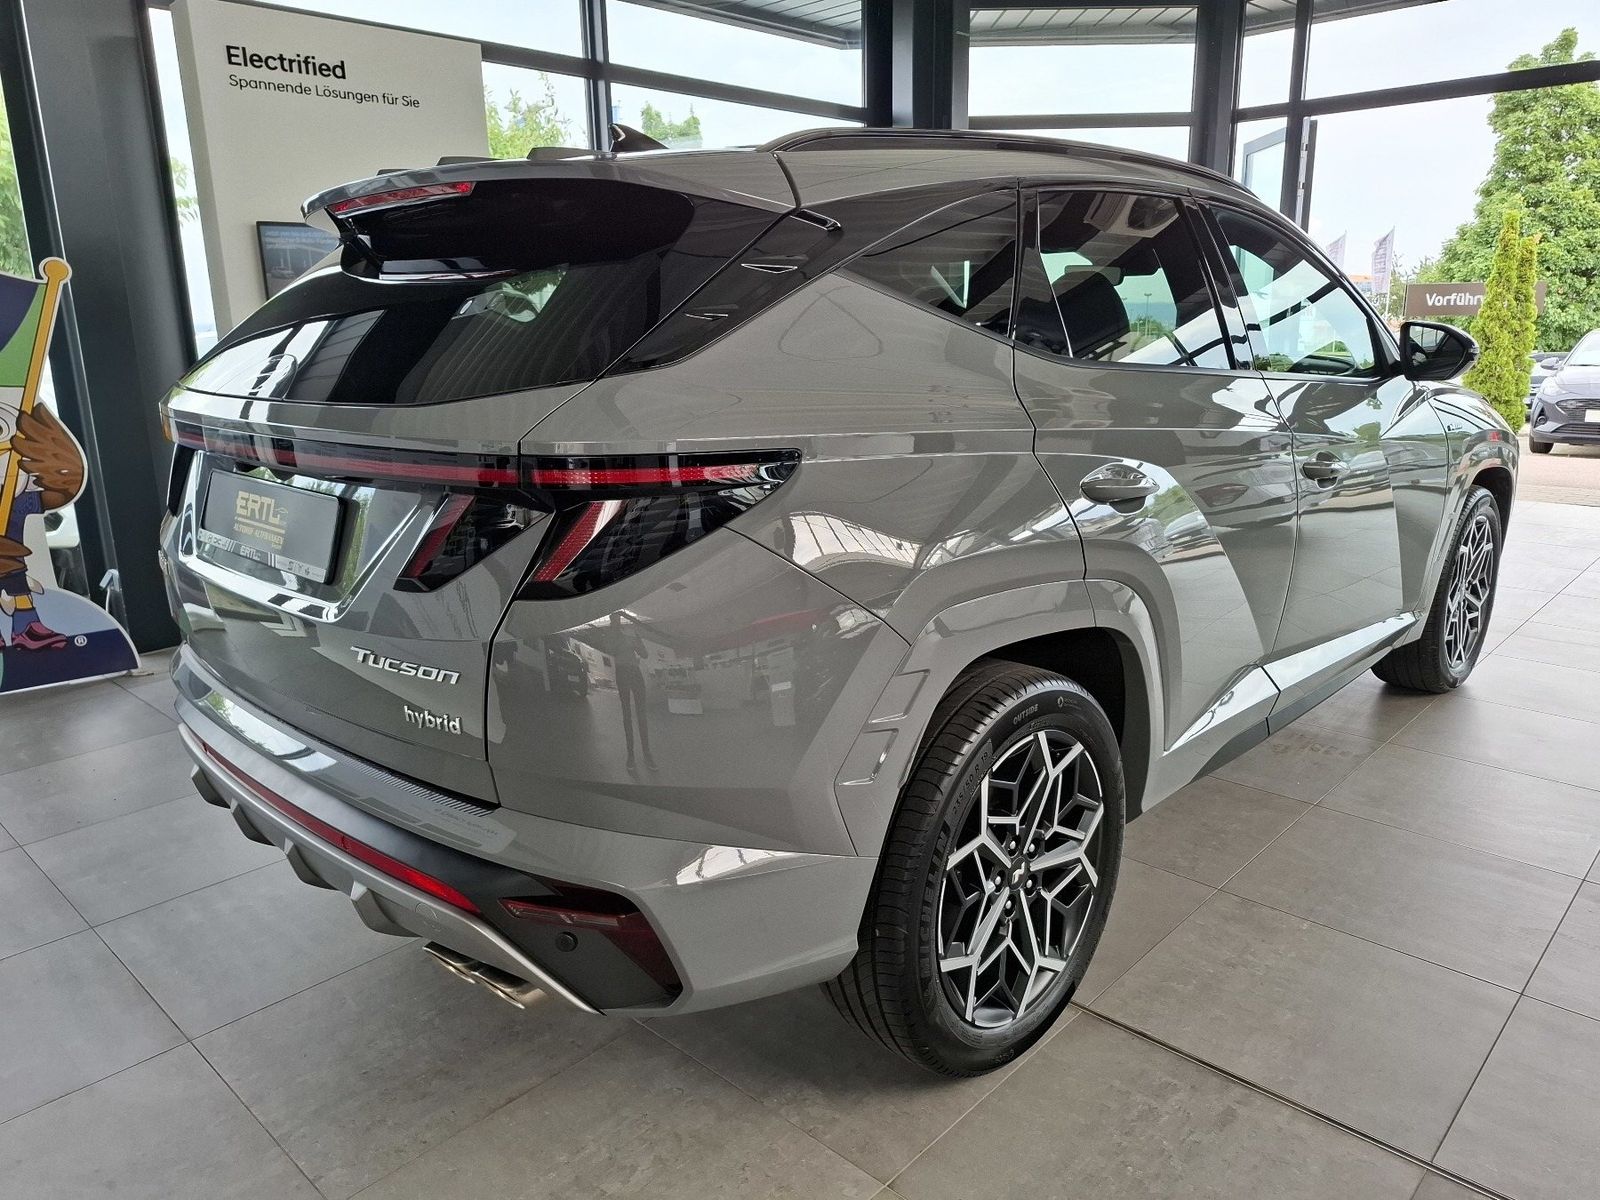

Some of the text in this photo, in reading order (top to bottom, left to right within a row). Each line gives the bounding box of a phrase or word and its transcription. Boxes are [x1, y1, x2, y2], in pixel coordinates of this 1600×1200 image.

[226, 45, 346, 79] Electrified
[229, 74, 420, 108] Spannende Lösungen für Sie
[1426, 292, 1484, 306] Vorführ
[236, 490, 280, 524] ERTL
[403, 705, 462, 735] hybrid
[1012, 703, 1040, 725] OUTSIDE
